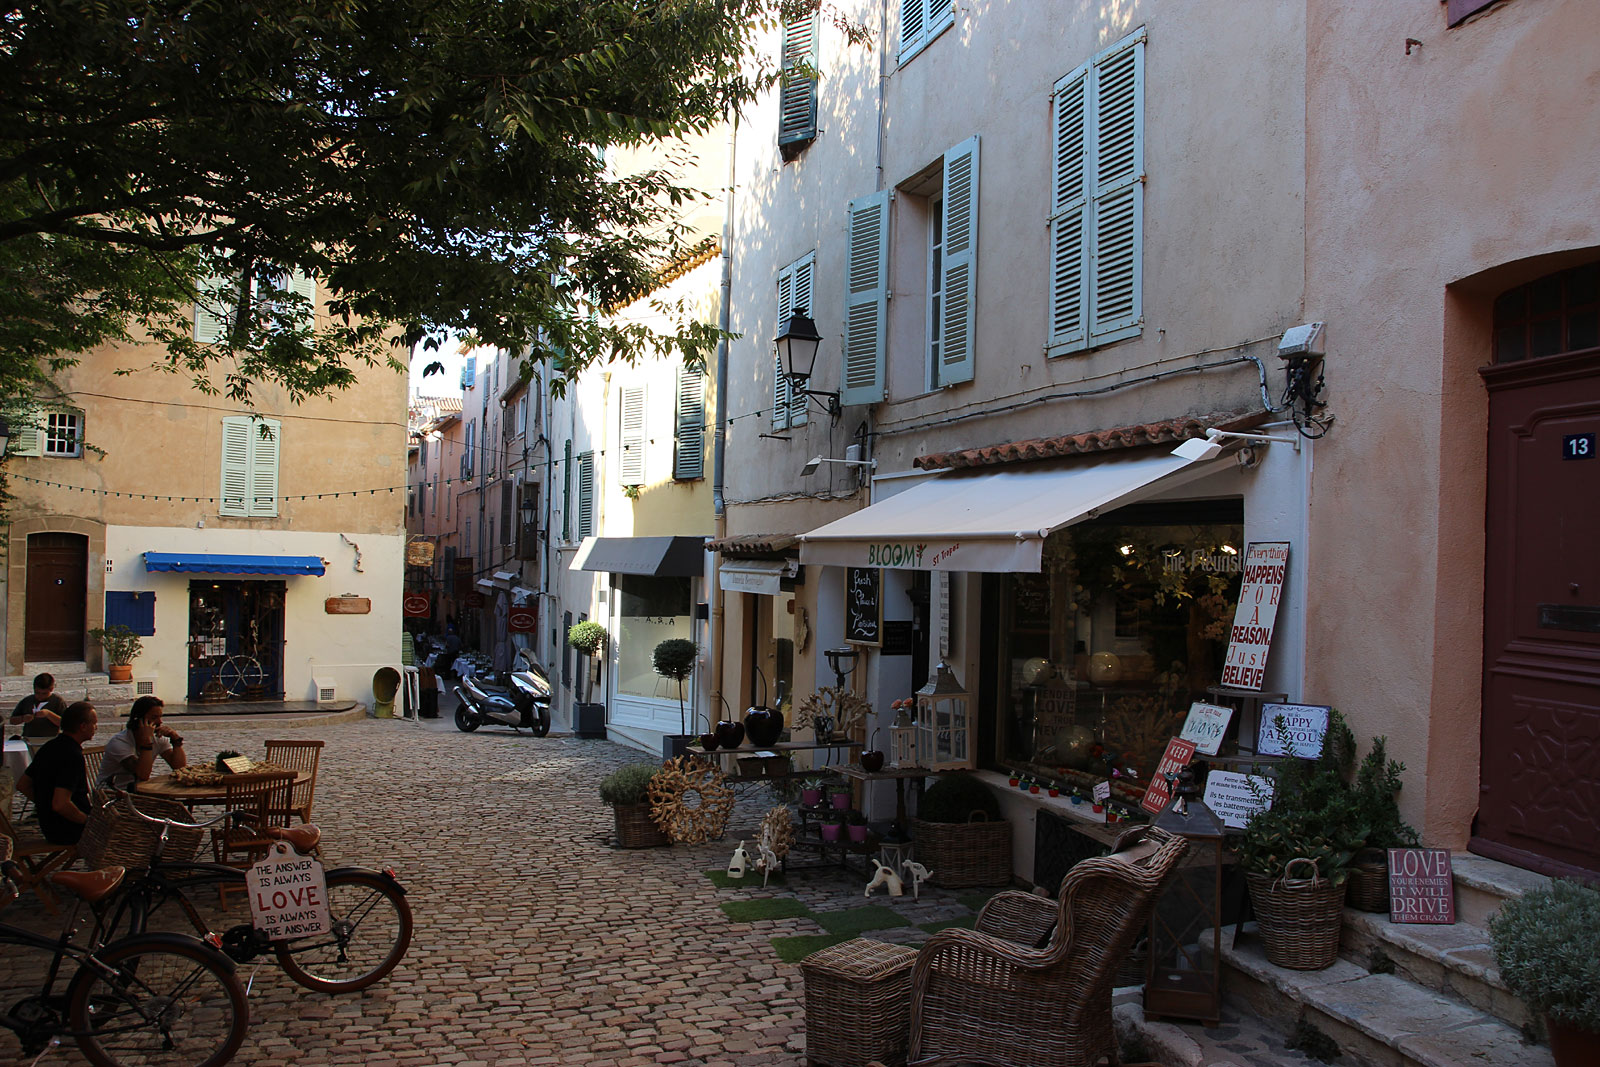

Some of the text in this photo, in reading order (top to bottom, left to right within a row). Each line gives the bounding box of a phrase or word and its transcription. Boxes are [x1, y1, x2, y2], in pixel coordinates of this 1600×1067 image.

[1569, 437, 1589, 456] 13
[869, 543, 927, 567] BLOOMY
[1161, 549, 1186, 572] The
[1247, 545, 1288, 563] Everything
[1243, 564, 1286, 585] HAPPENS
[1240, 584, 1280, 605] FOR
[1248, 605, 1259, 625] A
[1231, 625, 1271, 646] REASON.
[1227, 644, 1266, 667] Just
[1222, 664, 1264, 688] BELIEVE
[1283, 717, 1313, 728] APPY
[1287, 731, 1317, 743] YOU
[1169, 745, 1189, 760] KEEP
[1147, 792, 1167, 808] HEART
[1224, 802, 1258, 813] battements
[256, 860, 312, 876] THE ANSWER
[1390, 850, 1449, 877] LOVE
[259, 873, 311, 887] IS ALWAYS
[1391, 877, 1449, 886] YOUR ENEMIES
[257, 886, 320, 912] LOVE
[1392, 886, 1449, 897] IT WILL
[1392, 897, 1450, 914] DRIVE
[265, 910, 317, 925] IS ALWAYS
[1393, 913, 1449, 922] THEM CRAZY
[265, 922, 321, 936] THE ANSWER
